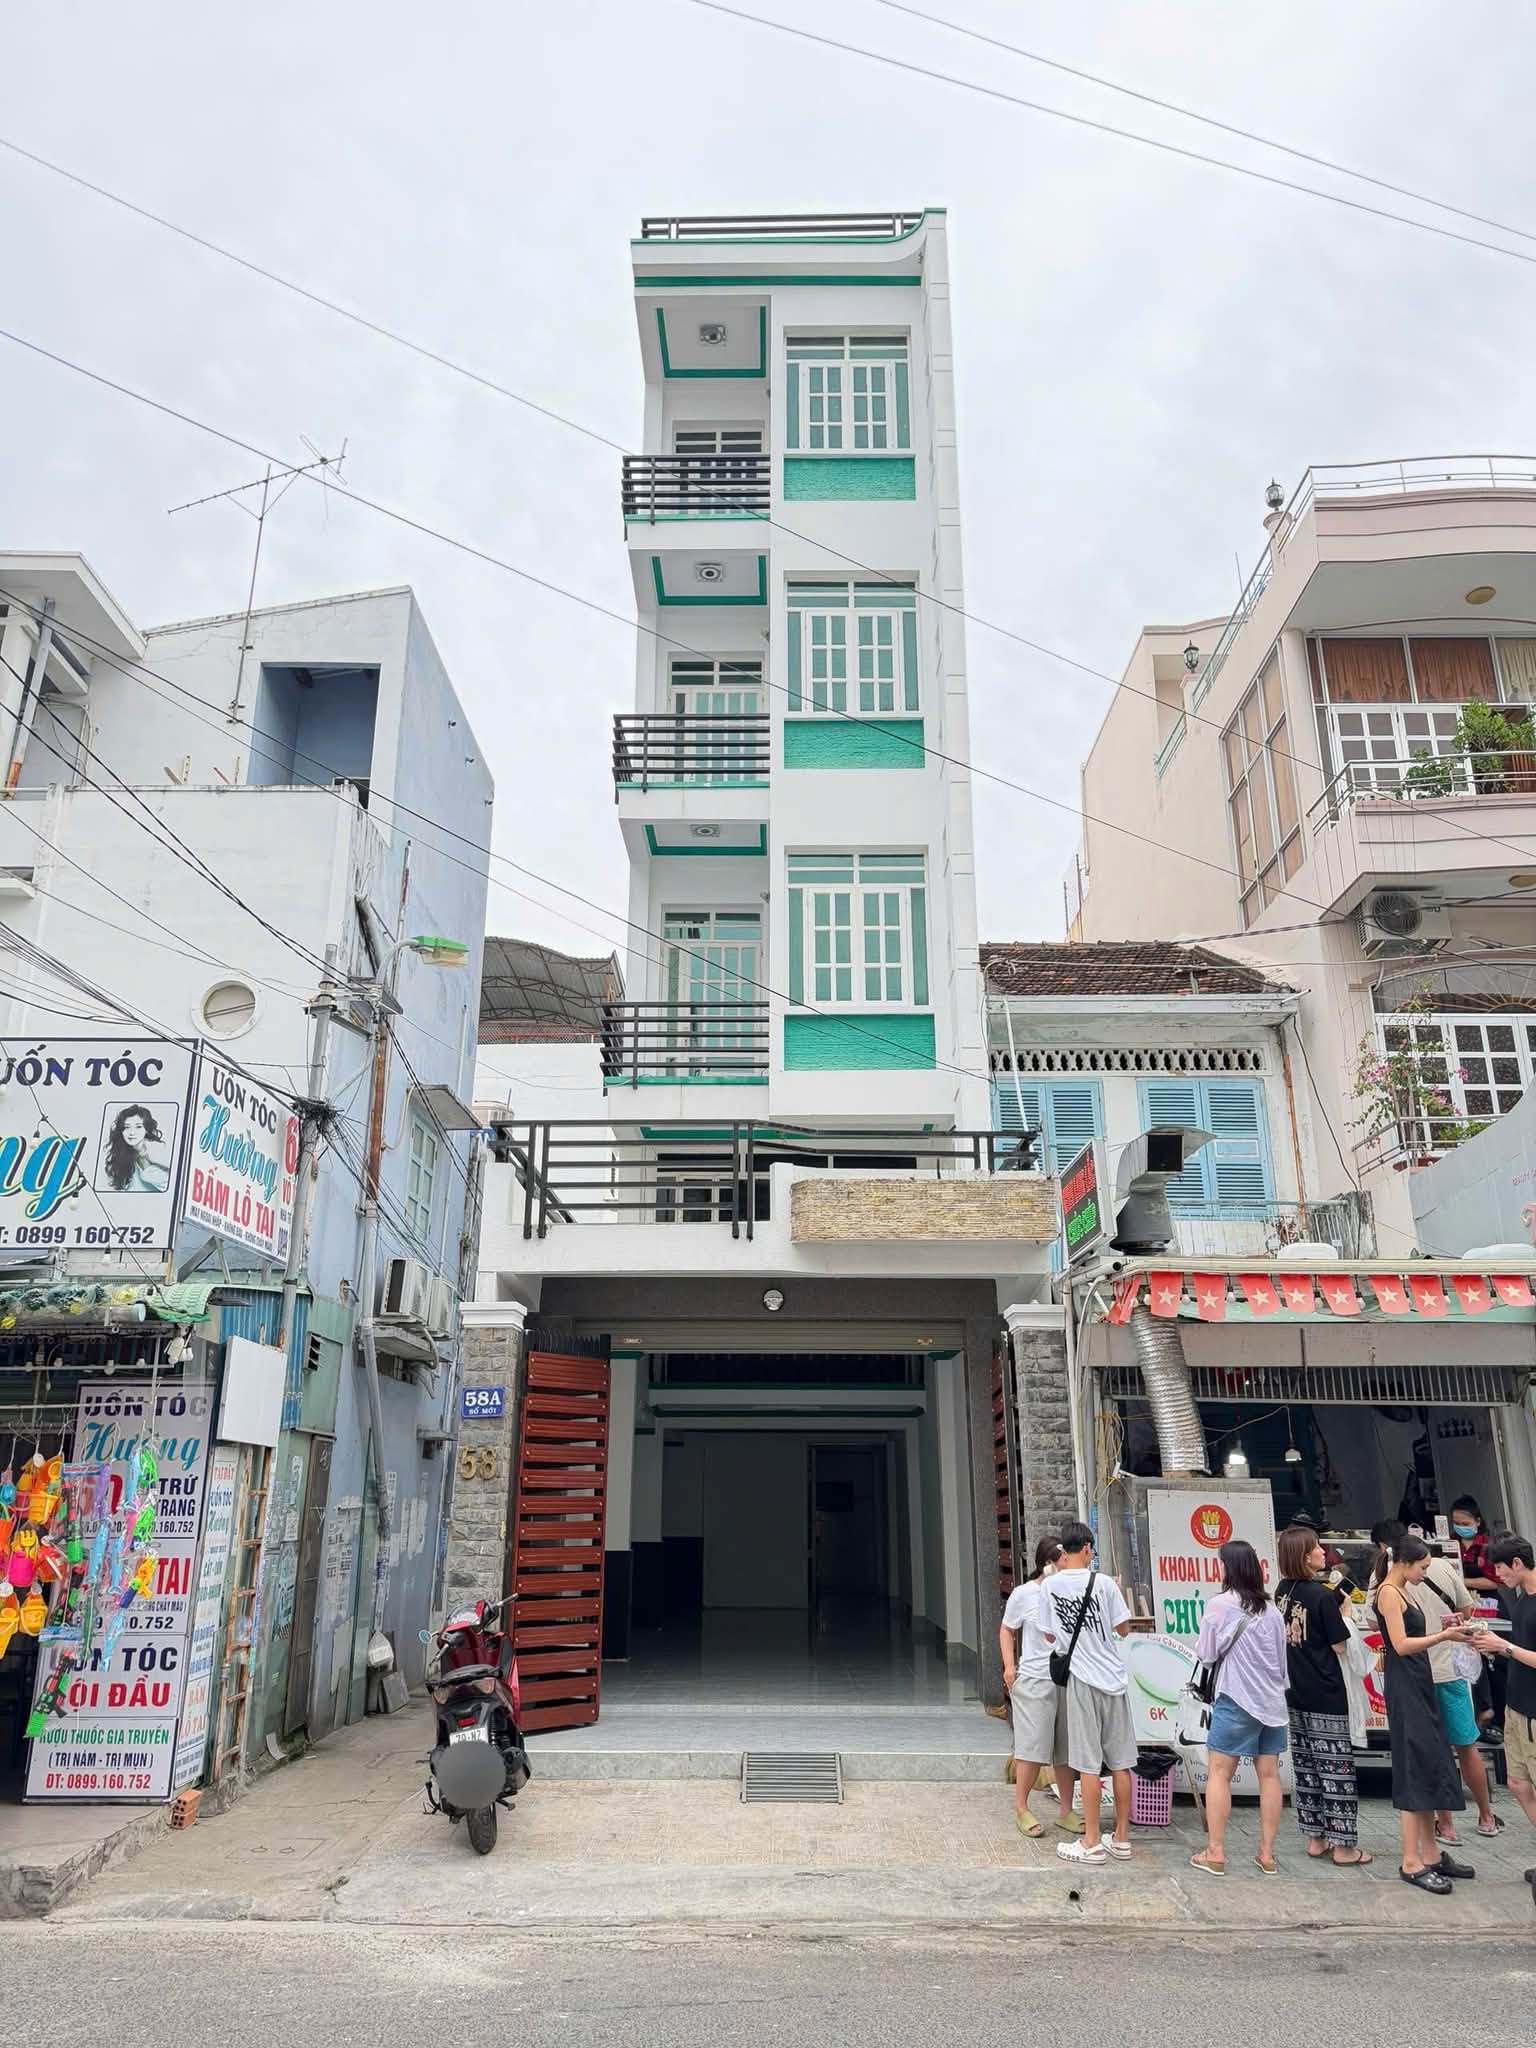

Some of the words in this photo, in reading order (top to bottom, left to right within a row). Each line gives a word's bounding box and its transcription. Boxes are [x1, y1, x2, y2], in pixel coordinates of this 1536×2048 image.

[85, 1050, 164, 1087] TÓC
[250, 1095, 277, 1134] TÓC
[192, 1166, 230, 1217] BẤM
[233, 1184, 252, 1227] LỖ
[256, 1201, 275, 1239] TAI
[15, 1226, 66, 1244] 0899
[74, 1226, 110, 1244] 160
[117, 1226, 155, 1244] 752
[85, 1389, 144, 1416] UỐN
[154, 1392, 207, 1416] TÓC
[465, 1391, 502, 1407] 58A
[461, 1445, 497, 1480] 58
[157, 1499, 196, 1516] RANG
[157, 1557, 191, 1595] TAI
[1158, 1556, 1201, 1582] KHOAI
[1204, 1557, 1223, 1583] LA
[122, 1642, 178, 1672] TÓC
[68, 1678, 99, 1713] ỘI
[108, 1674, 171, 1708] ĐẦU
[1149, 1707, 1169, 1721] 6K
[107, 1728, 124, 1744] GIA
[67, 1773, 151, 1789] 0899.160.752
